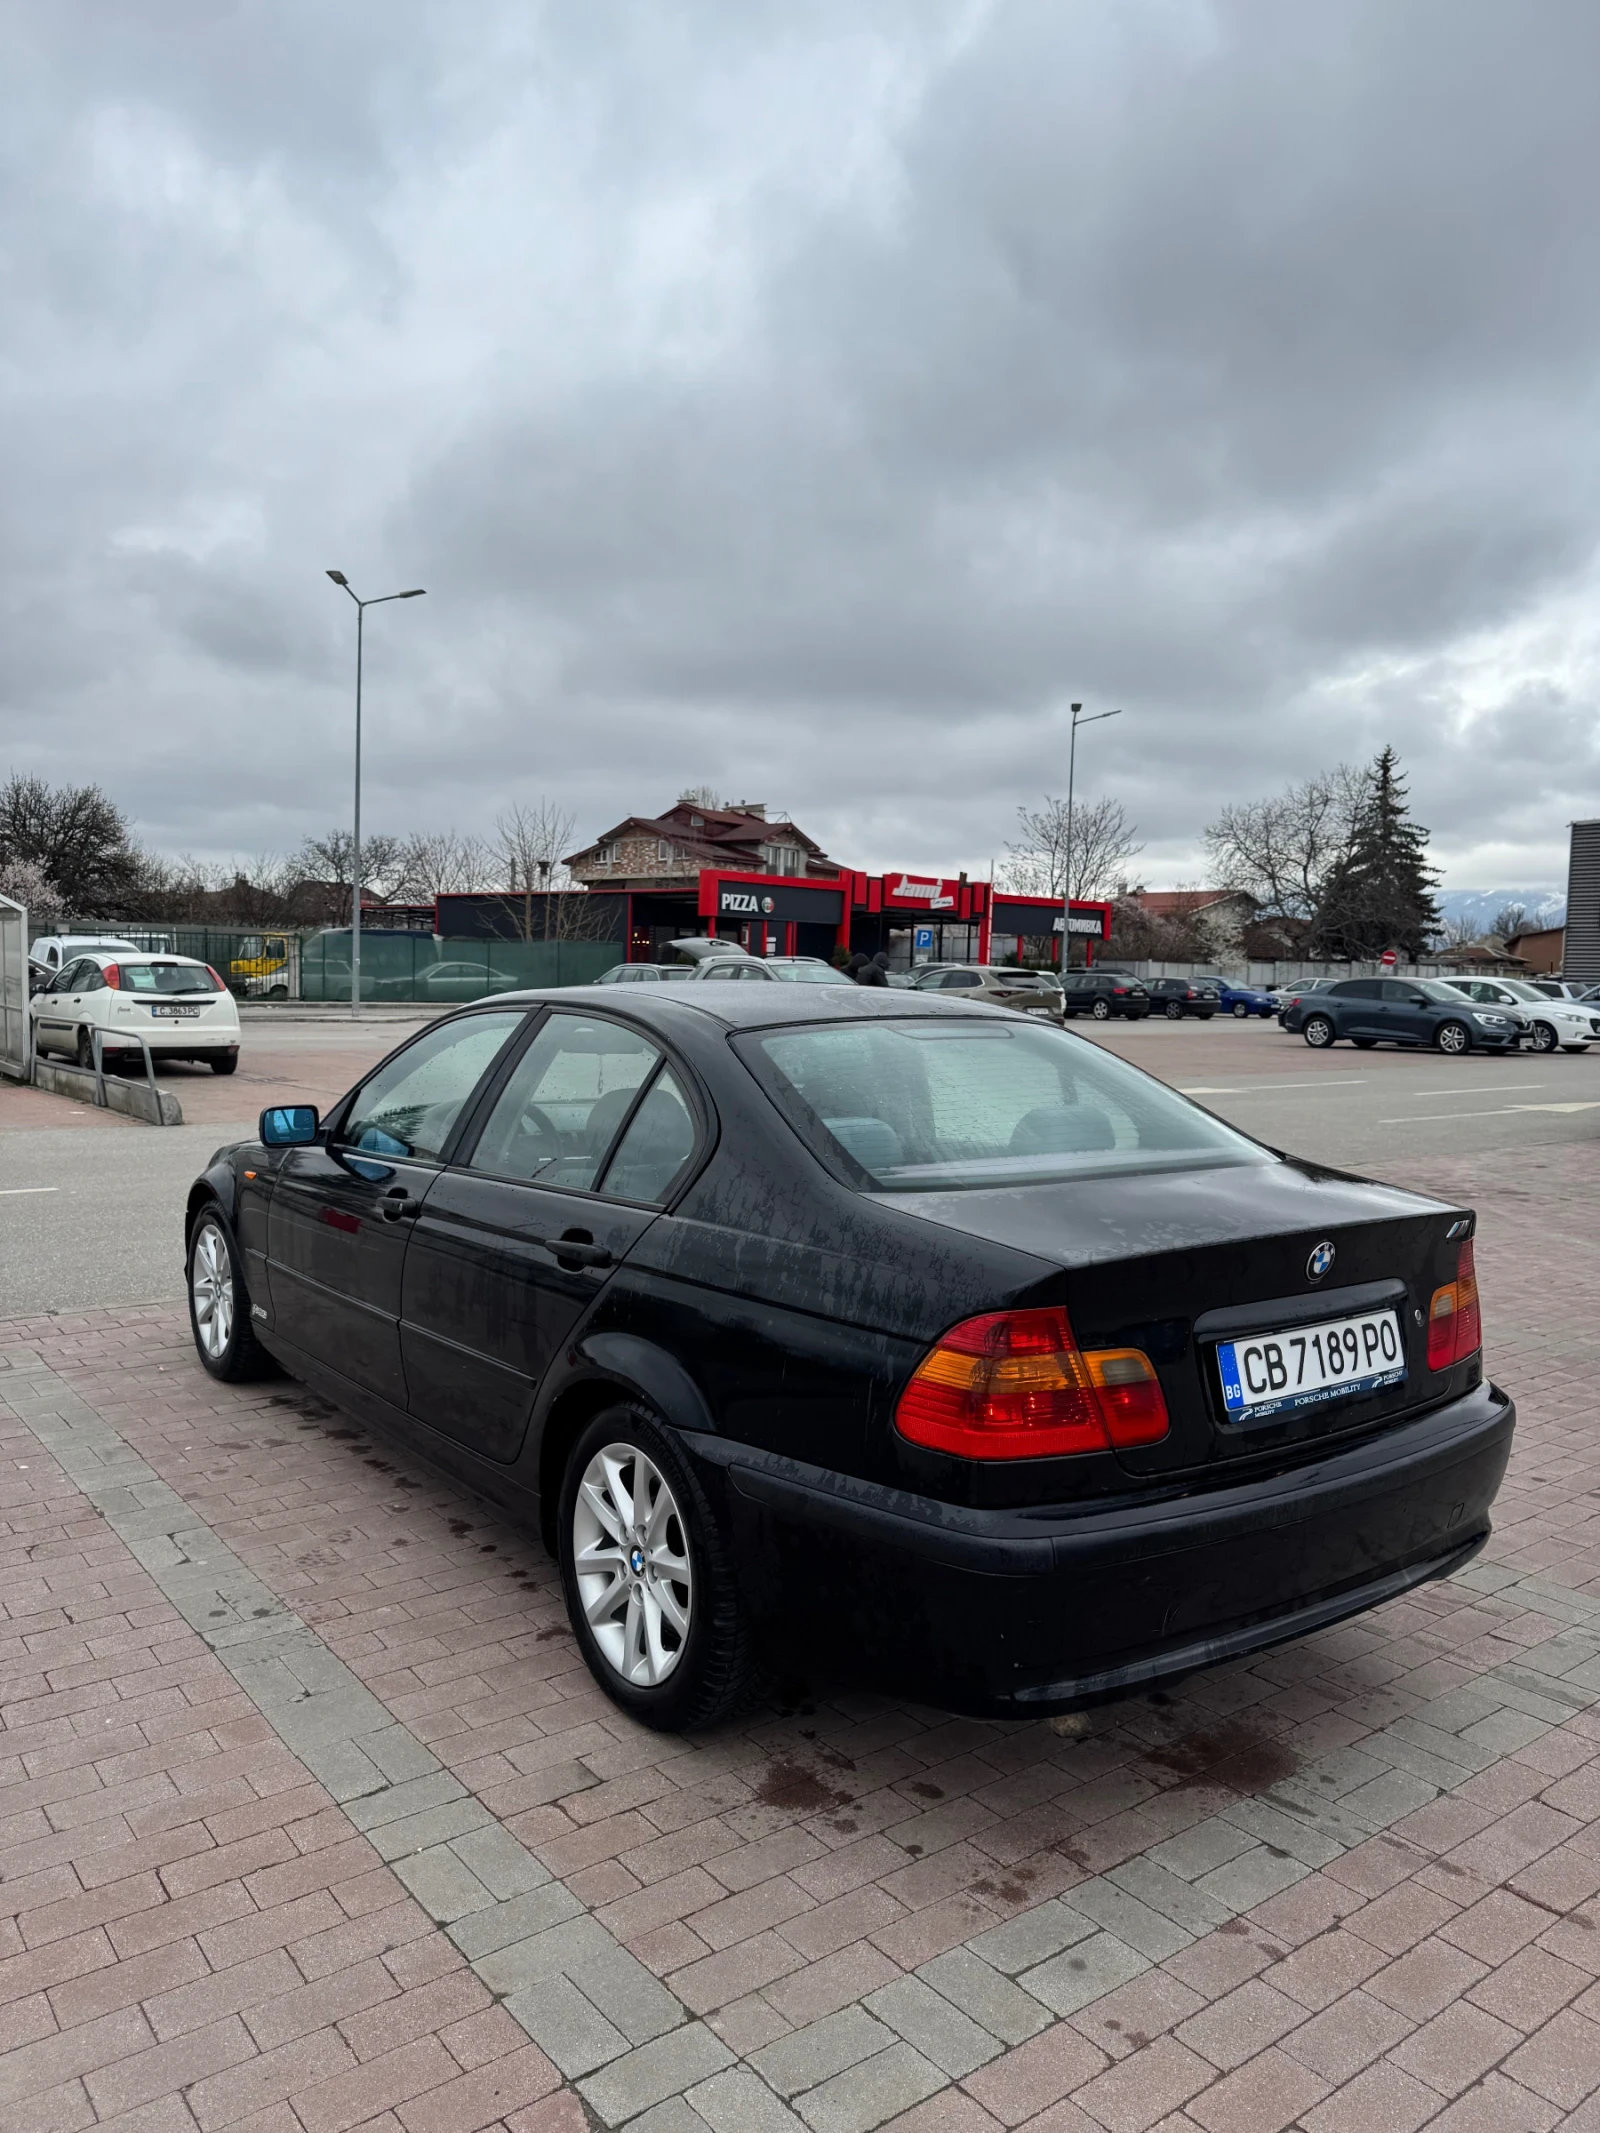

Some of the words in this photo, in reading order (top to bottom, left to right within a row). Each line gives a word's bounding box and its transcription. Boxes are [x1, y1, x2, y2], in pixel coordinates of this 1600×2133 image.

[721, 893, 759, 912] PIZZA
[1052, 917, 1102, 934] АВОМИВКА
[920, 932, 929, 945] P
[1226, 1383, 1241, 1400] BG
[1294, 1391, 1329, 1406] PORSCHE
[1330, 1383, 1361, 1398] MOBILITY
